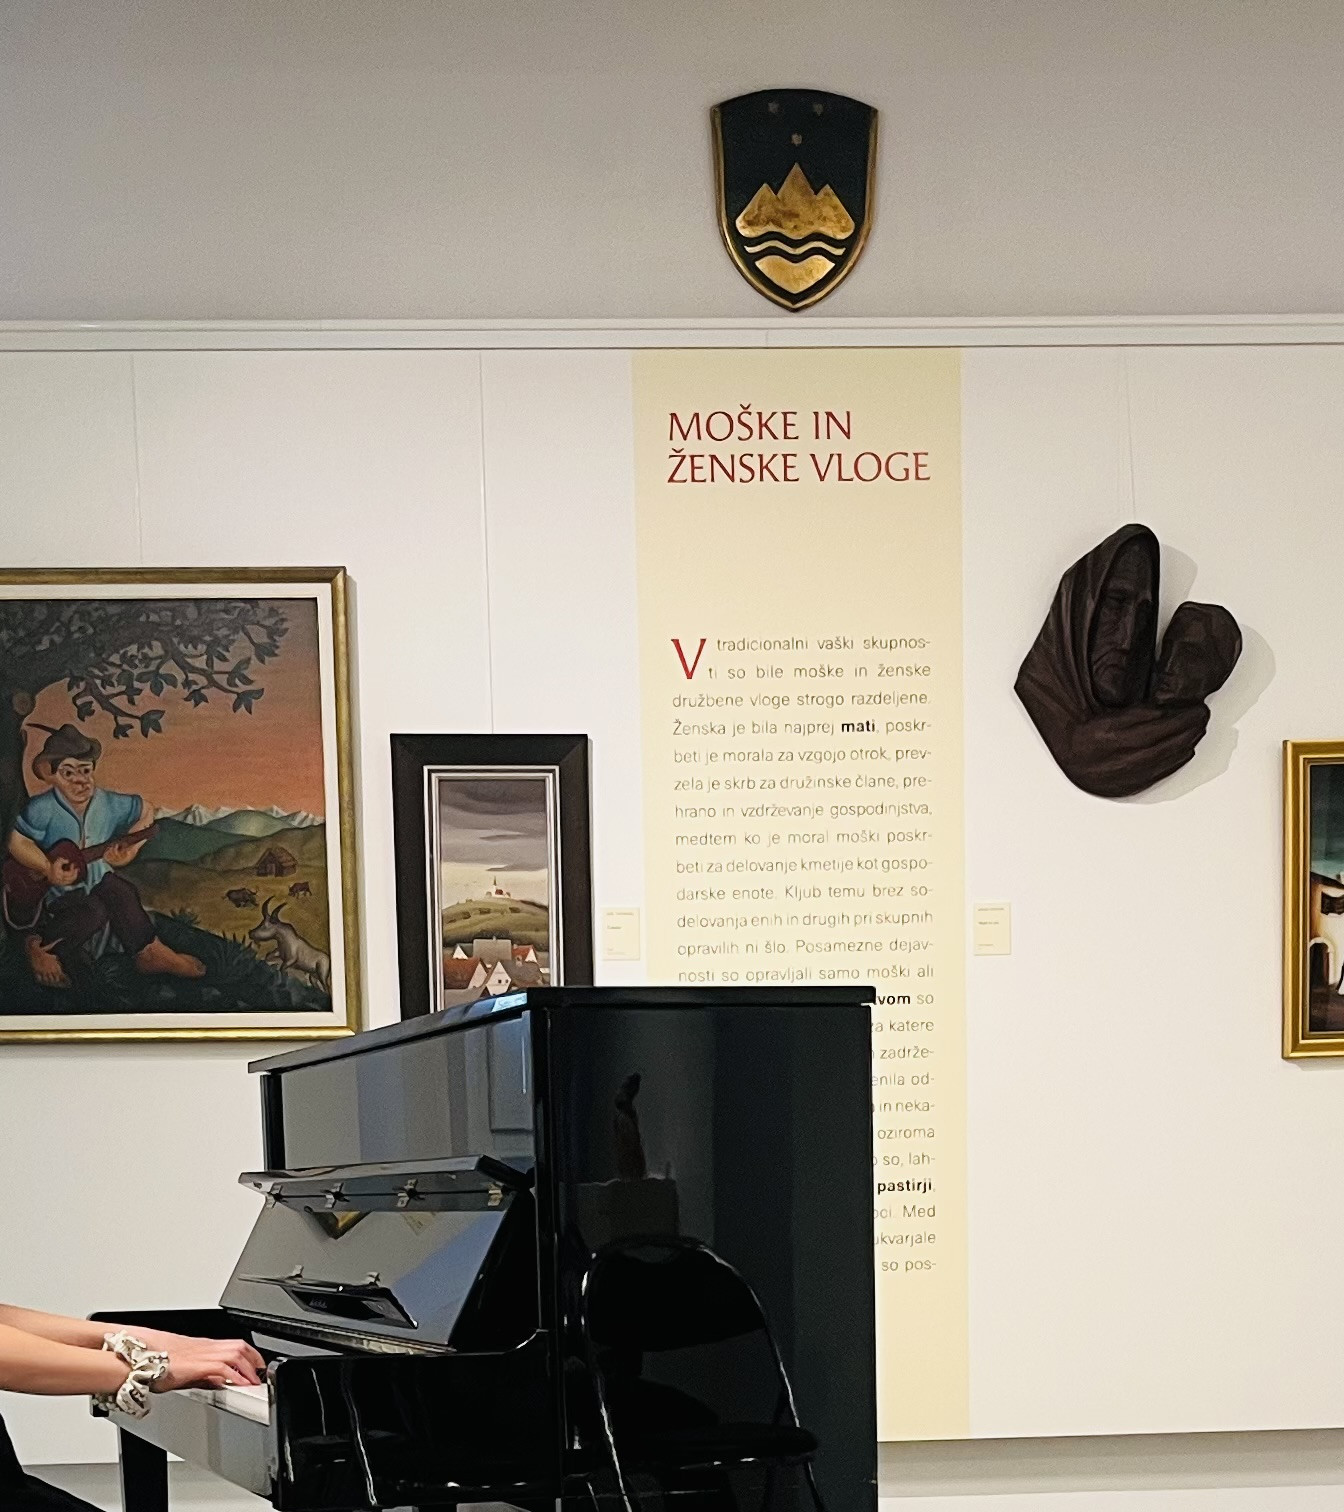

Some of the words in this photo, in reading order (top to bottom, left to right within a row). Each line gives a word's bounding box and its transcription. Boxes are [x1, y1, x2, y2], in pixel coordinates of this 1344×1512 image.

[668, 403, 800, 442] MOŠKE
[813, 410, 852, 441] IN
[666, 447, 801, 484] ŽENSKE
[808, 451, 932, 483] VLOGE
[670, 638, 707, 680] V
[716, 637, 809, 651] tradicionalni
[817, 636, 854, 650] vaški
[862, 636, 932, 652] skupnos-
[708, 667, 717, 680] ti
[727, 667, 746, 679] so
[755, 665, 784, 679] bile
[793, 664, 844, 678] moške
[854, 665, 868, 678] in
[876, 662, 931, 677] ženske
[672, 693, 744, 708] družbene
[749, 693, 791, 709] vloge
[796, 693, 845, 709] strogo
[672, 718, 726, 736] Ženska
[732, 720, 746, 737] je
[751, 720, 778, 735] bila
[783, 720, 835, 737] najprej
[840, 719, 880, 735] mati,
[885, 718, 932, 735] poskr-
[673, 749, 700, 764] beti
[705, 749, 719, 766] je
[723, 748, 774, 763] morala
[777, 751, 794, 763] za
[797, 749, 847, 764] vzgojo
[895, 748, 933, 763] prev-
[673, 776, 704, 792] zela
[706, 777, 721, 794] je
[724, 776, 757, 791] skrb
[759, 778, 776, 790] za
[779, 775, 852, 790] družinske
[855, 774, 900, 790] člane,
[903, 776, 933, 790] pre-
[675, 805, 717, 819] hrano
[722, 807, 735, 818] in
[740, 804, 824, 820] vzdrževanje
[675, 832, 737, 847] medtem
[744, 832, 762, 846] ko
[767, 832, 781, 849] je
[787, 830, 829, 845] moral
[836, 829, 880, 844] moški
[886, 829, 933, 846] poskr-
[676, 859, 704, 875] beti
[706, 862, 723, 874] za
[726, 858, 798, 875] delovanje
[800, 857, 855, 874] kmetije
[857, 856, 879, 871] kot
[881, 858, 933, 873] gospo-
[676, 887, 726, 902] darske
[784, 885, 822, 902] Kljub
[827, 885, 866, 899] temu
[872, 883, 904, 898] brez
[910, 884, 934, 897] so-
[676, 914, 748, 930] delovanja
[750, 913, 783, 928] enih
[786, 913, 799, 927] in
[801, 912, 850, 930] drugih
[853, 912, 873, 928] pri
[875, 910, 933, 927] skupnih
[677, 941, 739, 957] opravilih
[745, 941, 759, 955] ni
[795, 938, 883, 955] Posamezne
[889, 938, 934, 955] dejav-
[678, 969, 716, 983] nosti
[721, 969, 740, 982] so
[745, 967, 812, 984] opravljali
[818, 967, 860, 980] samo
[866, 965, 911, 979] moški
[917, 965, 934, 978] ali
[916, 994, 934, 1005] so
[889, 1020, 934, 1032] katere
[879, 1045, 935, 1060] zadrže-
[911, 1072, 935, 1086] od-
[879, 1102, 892, 1113] in
[895, 1099, 935, 1112] neka-
[877, 1127, 935, 1140] oziroma
[882, 1154, 904, 1167] so,
[908, 1151, 936, 1165] lah-
[902, 1204, 936, 1218] Med
[881, 1261, 899, 1272] so
[905, 1259, 937, 1273] pos-
